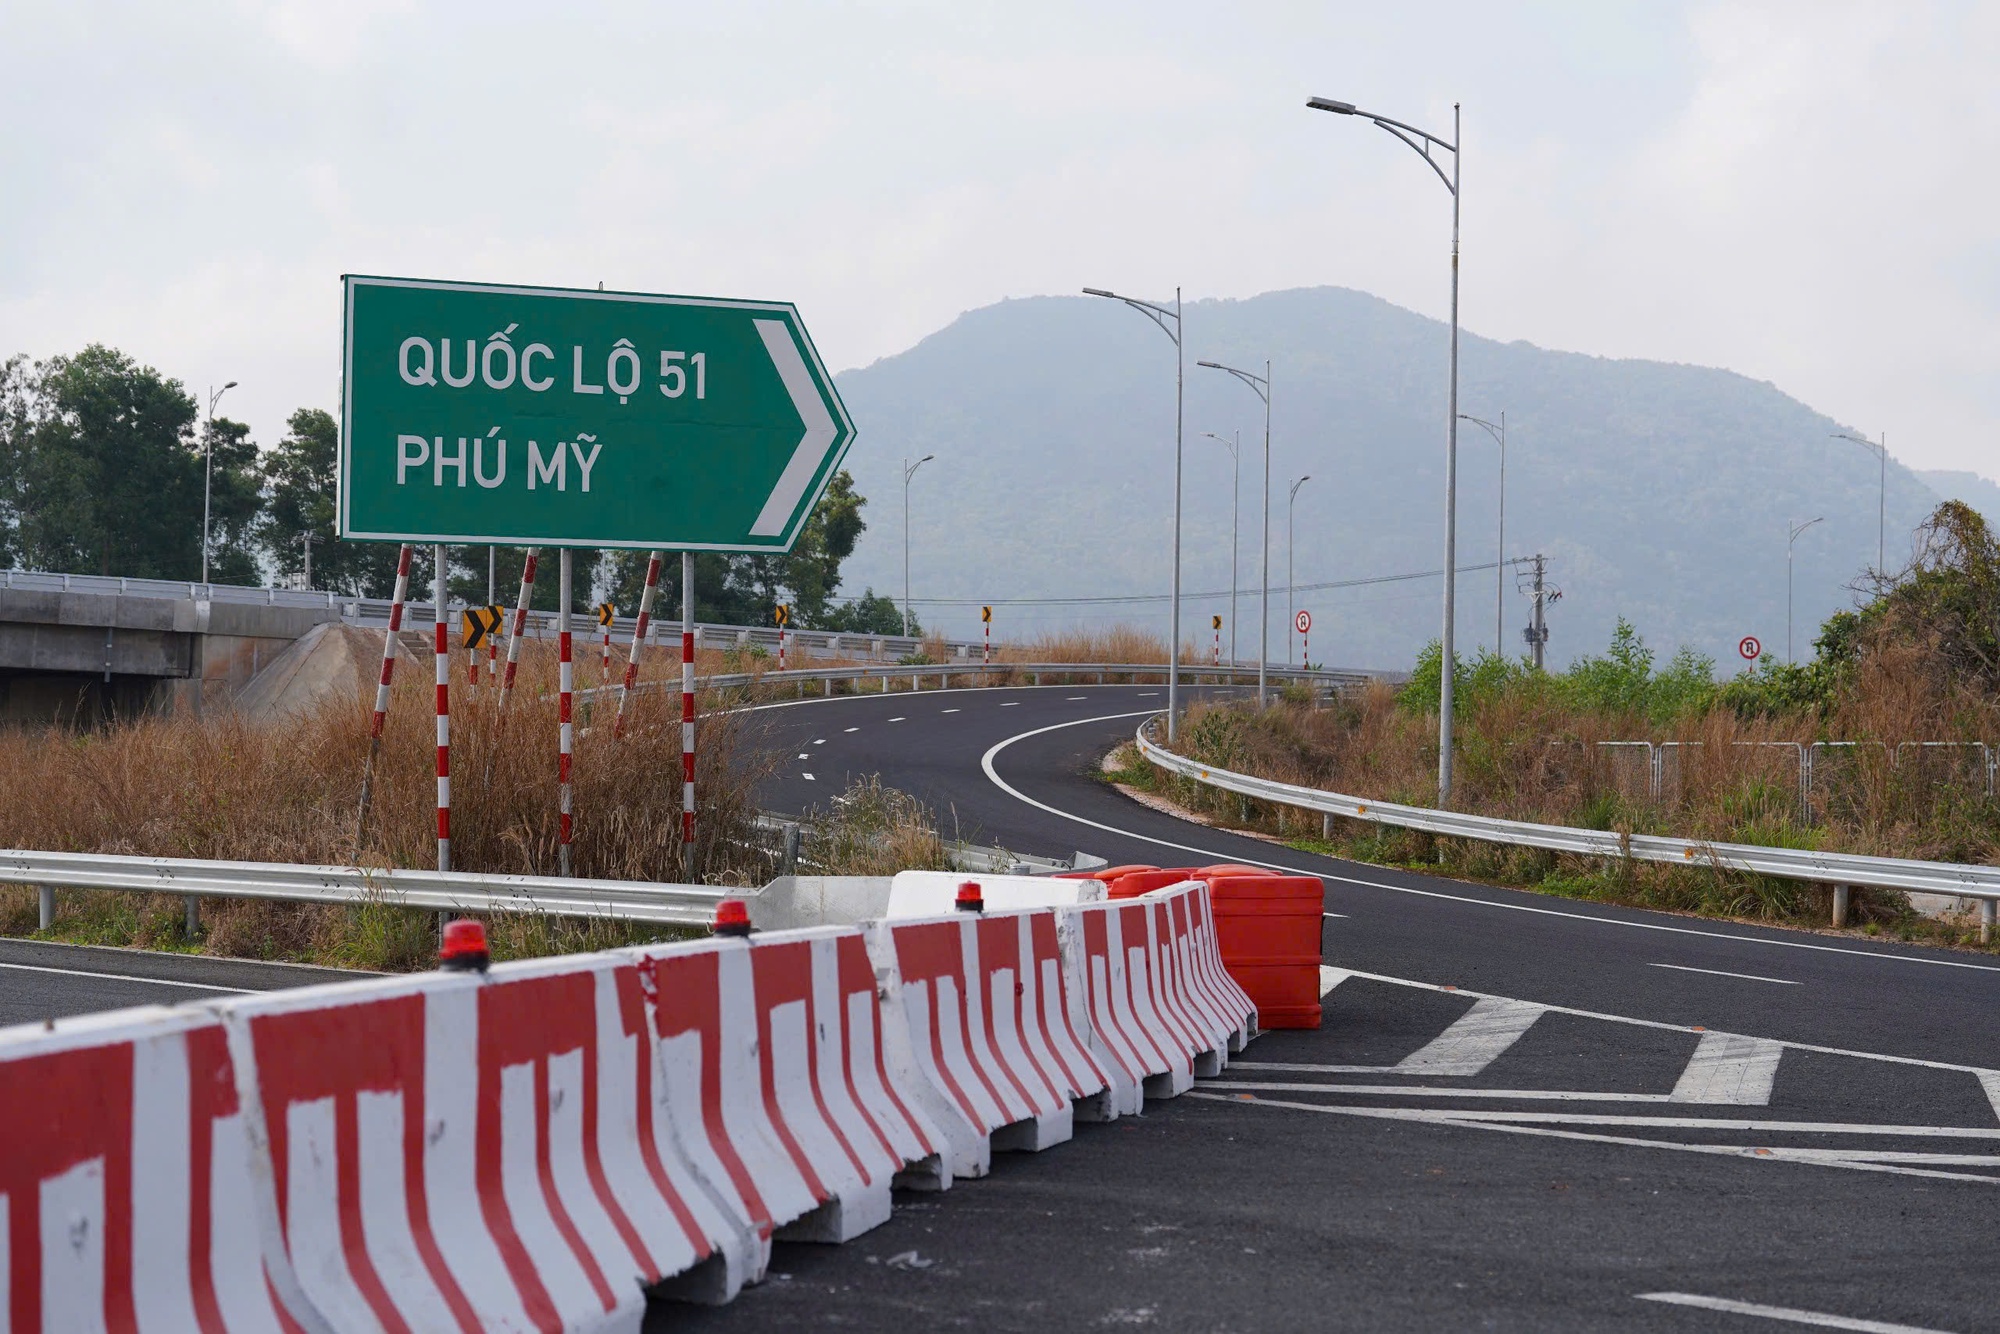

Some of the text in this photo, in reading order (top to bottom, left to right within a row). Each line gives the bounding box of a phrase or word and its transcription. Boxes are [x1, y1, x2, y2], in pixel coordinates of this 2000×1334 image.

[398, 323, 706, 404] QUỐC LỘ 51
[397, 426, 603, 492] PHÚ MỸ
